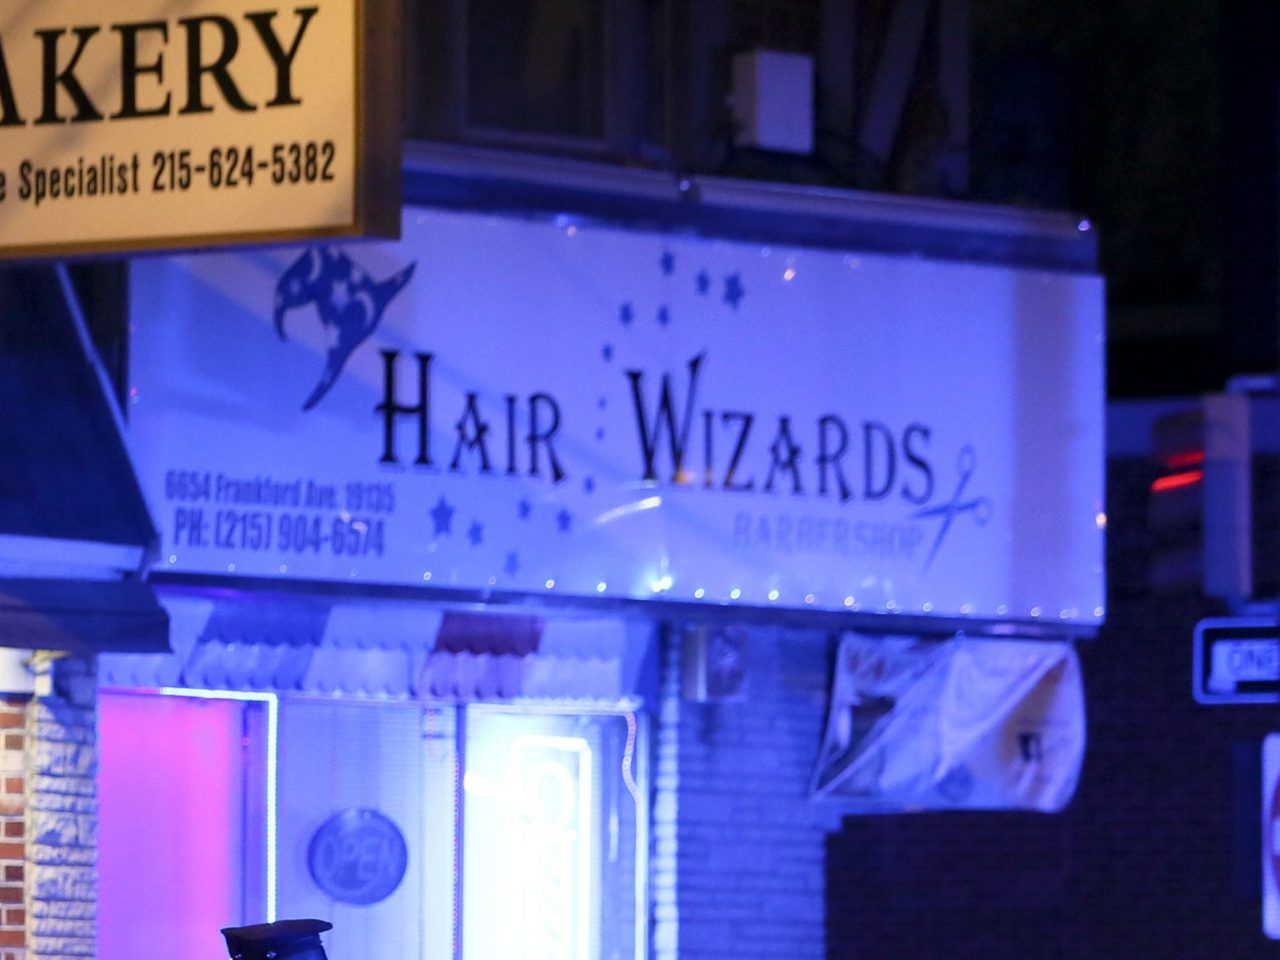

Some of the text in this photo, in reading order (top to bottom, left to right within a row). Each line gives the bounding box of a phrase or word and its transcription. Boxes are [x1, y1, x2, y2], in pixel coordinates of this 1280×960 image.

[18, 153, 140, 206] Specialist
[151, 139, 336, 193] 215-624-5382
[375, 347, 936, 506] HAIR WIZARDS
[215, 509, 274, 551] (215)
